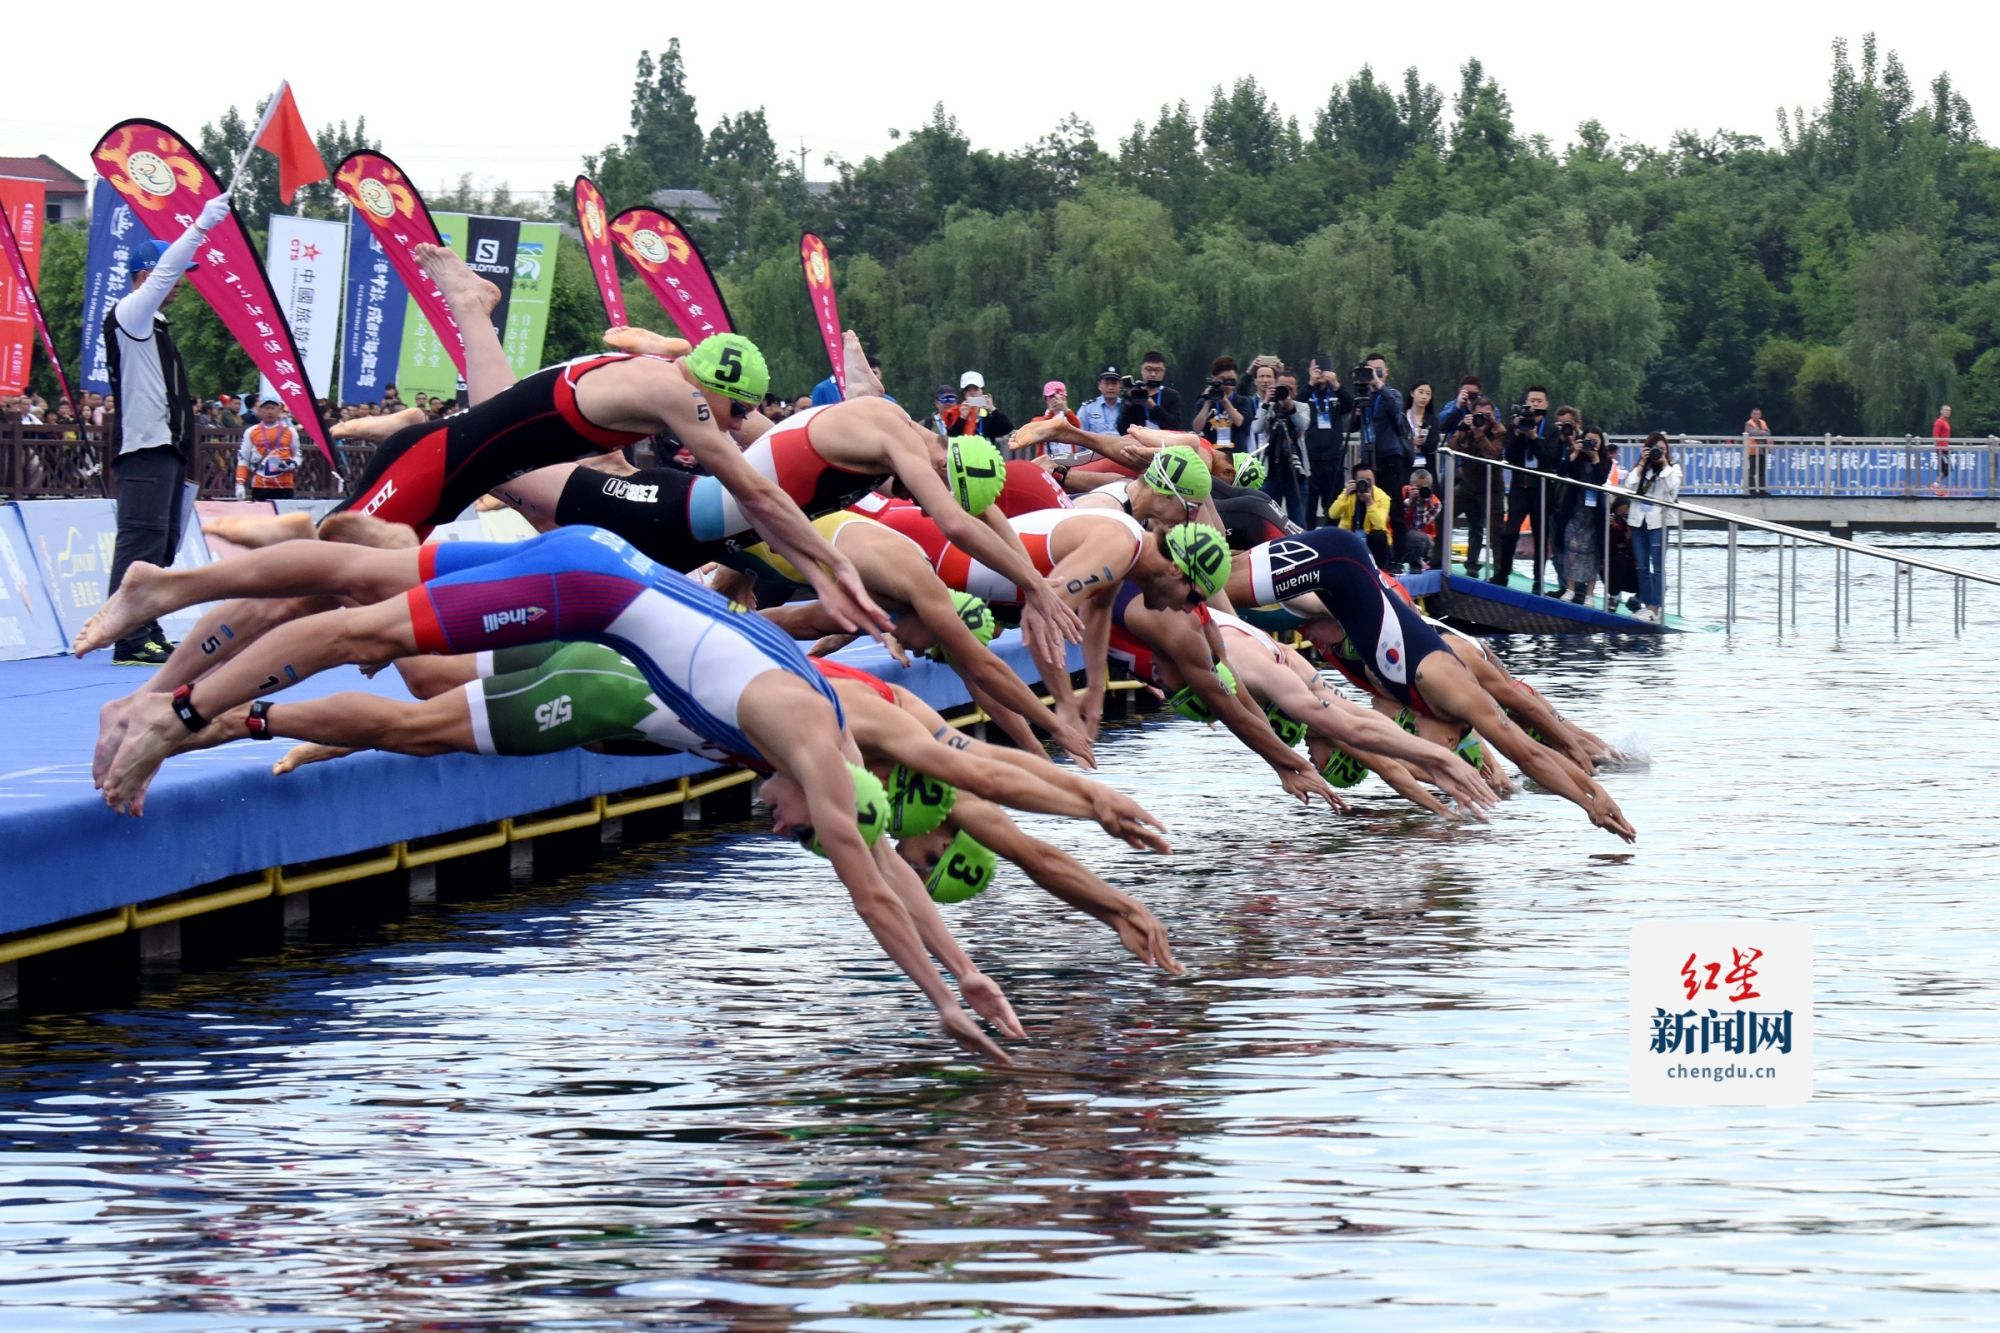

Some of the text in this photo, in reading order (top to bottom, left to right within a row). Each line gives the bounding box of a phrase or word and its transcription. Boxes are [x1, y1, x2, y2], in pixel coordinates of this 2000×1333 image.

[290, 239, 300, 261] CTS
[715, 347, 742, 383] 5
[697, 404, 710, 421] 5
[965, 459, 997, 478] 7
[1187, 532, 1225, 576] 10
[1067, 574, 1100, 594] 10
[1275, 570, 1320, 596] kiwami
[202, 636, 221, 654] 5
[259, 675, 280, 690] 1
[948, 735, 970, 751] 2
[907, 772, 943, 807] 2
[948, 853, 984, 887] 3
